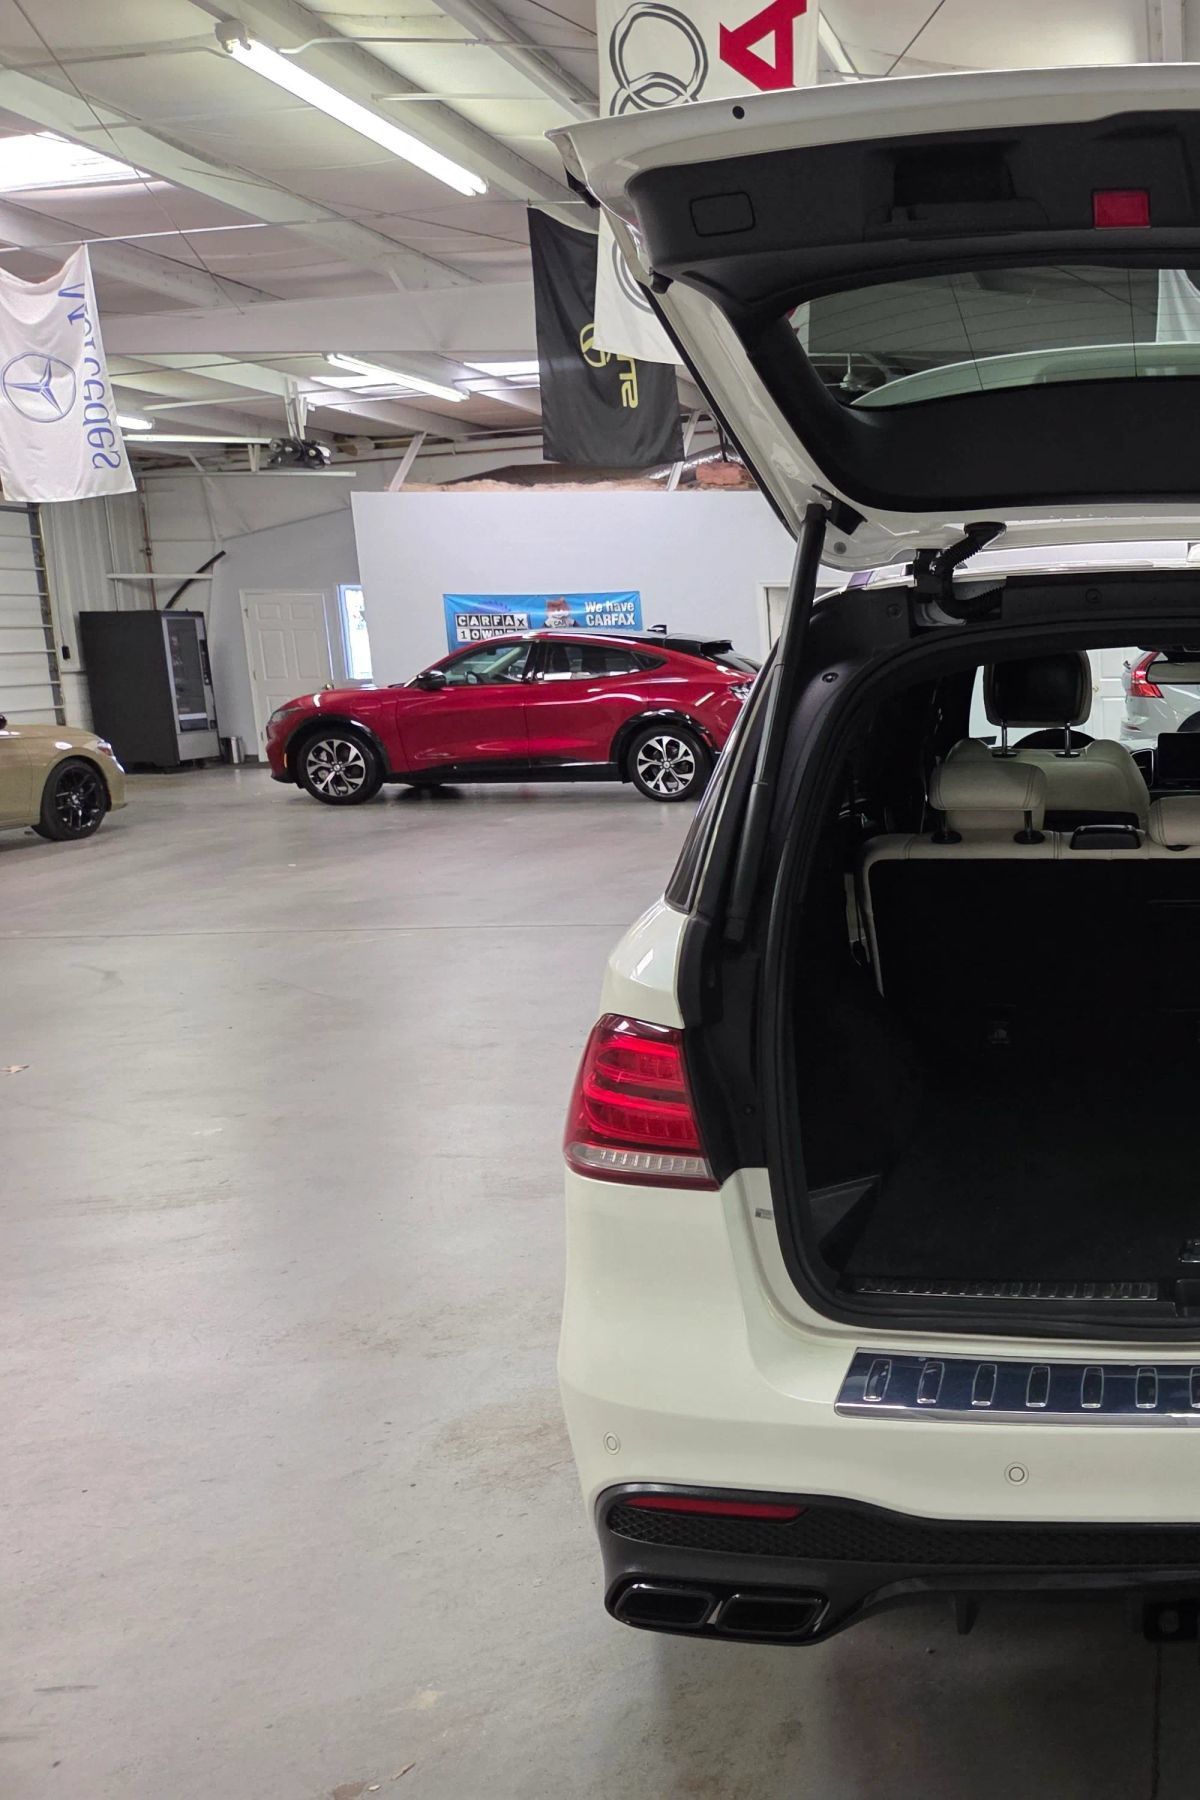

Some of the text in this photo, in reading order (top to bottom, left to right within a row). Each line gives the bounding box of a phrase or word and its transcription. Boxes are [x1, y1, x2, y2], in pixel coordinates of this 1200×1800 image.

[584, 601, 635, 612] We have
[457, 615, 525, 627] CARFAX
[586, 614, 636, 626] CARFAX
[470, 629, 516, 640] OWN
